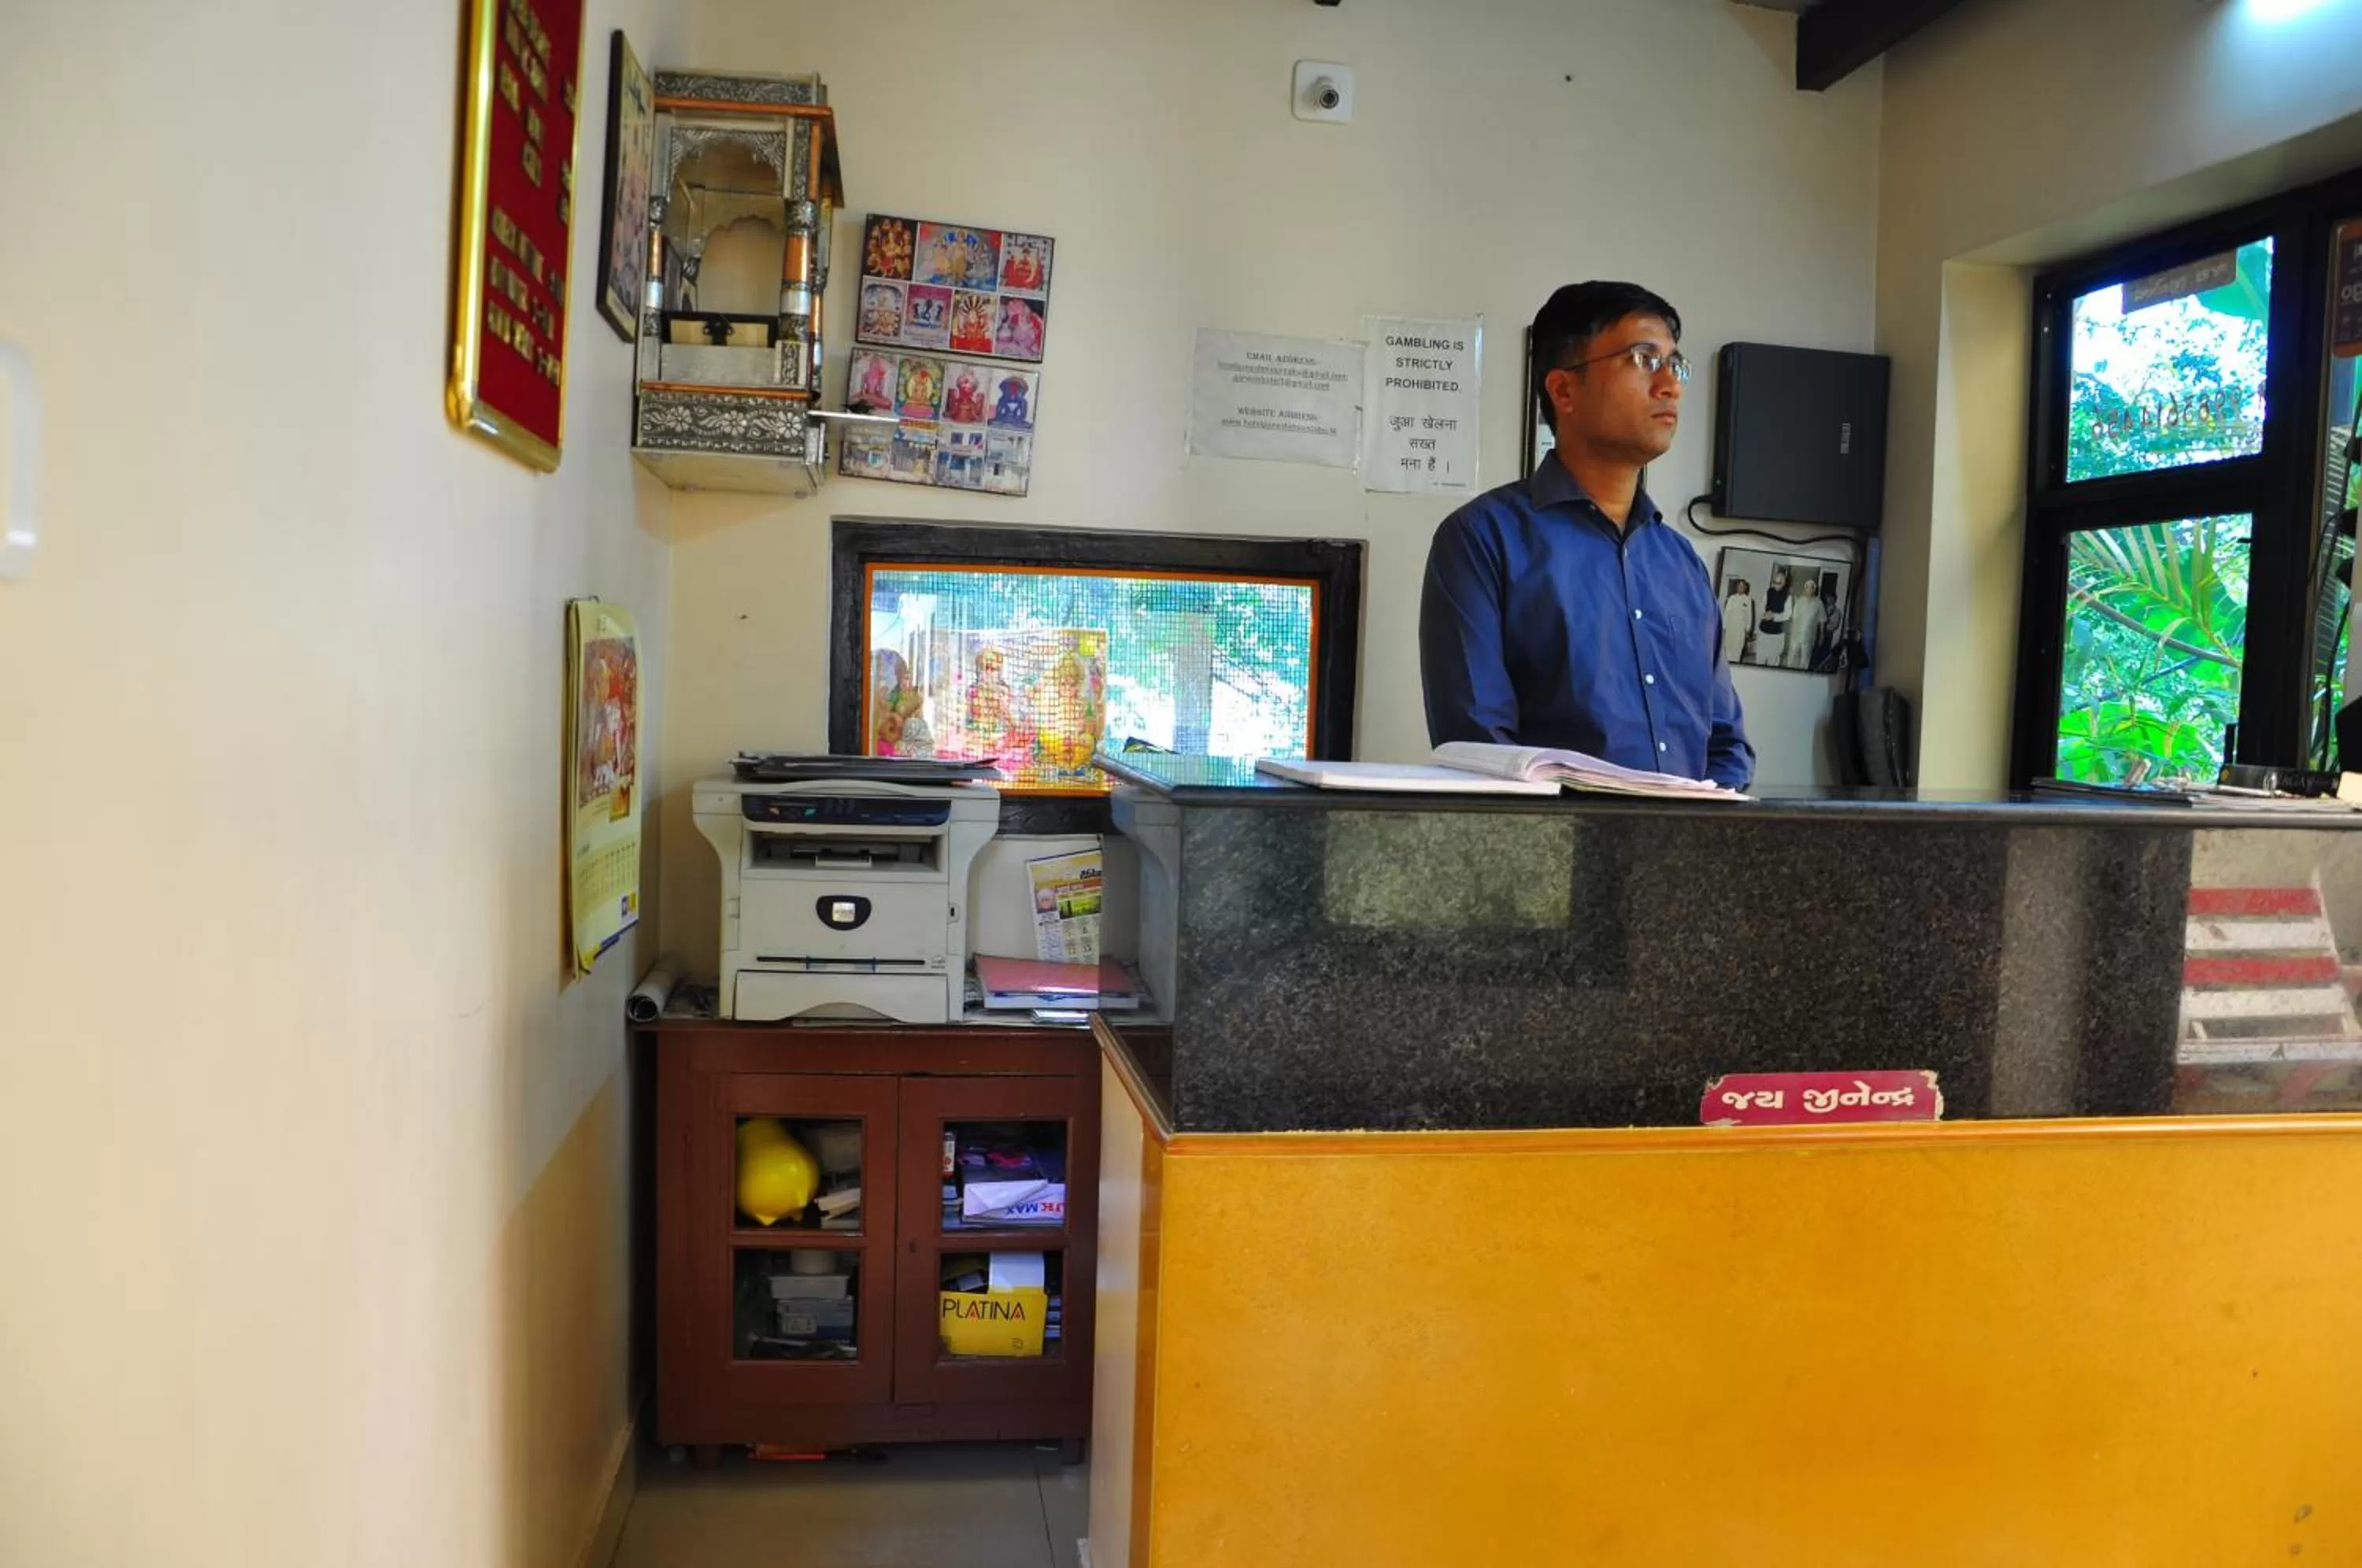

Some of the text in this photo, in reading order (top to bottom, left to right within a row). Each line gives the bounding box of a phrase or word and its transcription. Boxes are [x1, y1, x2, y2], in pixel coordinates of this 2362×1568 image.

[1385, 335, 1464, 352] GAMBLING IS
[1395, 357, 1453, 372] STRICTLY
[1422, 415, 1458, 431] खेलना
[1400, 457, 1422, 470] मना
[1721, 1089, 1783, 1111] જય
[1005, 1202, 1038, 1215] MAX
[942, 1297, 1027, 1322] PLATINA
